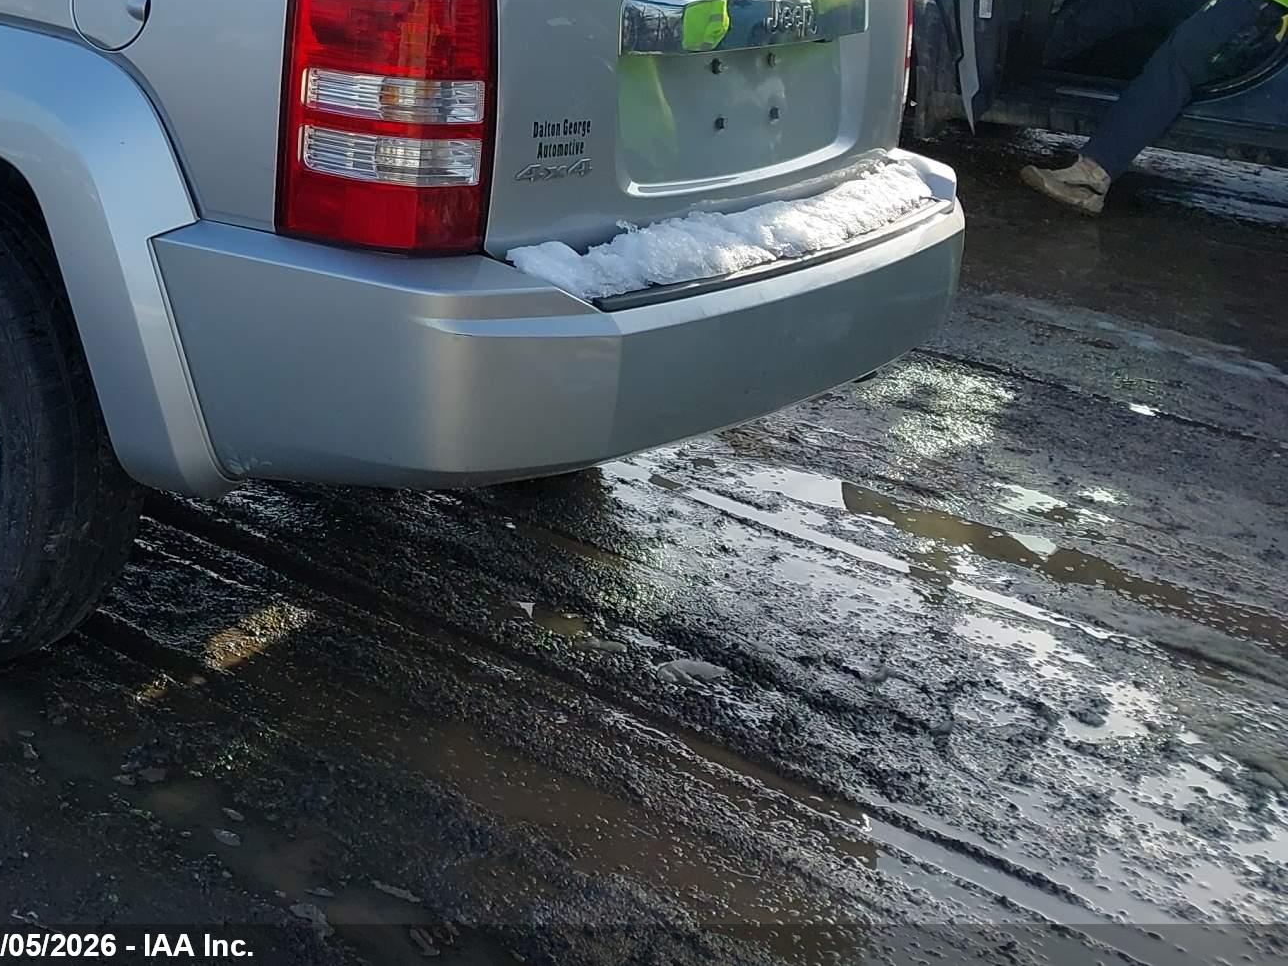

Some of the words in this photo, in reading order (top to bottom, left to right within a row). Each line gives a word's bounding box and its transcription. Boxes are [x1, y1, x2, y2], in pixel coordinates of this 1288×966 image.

[764, 0, 818, 38] Jeep
[533, 121, 561, 138] Dalton
[563, 119, 592, 137] George
[537, 139, 585, 159] Automotive
[514, 157, 593, 182] 4x4
